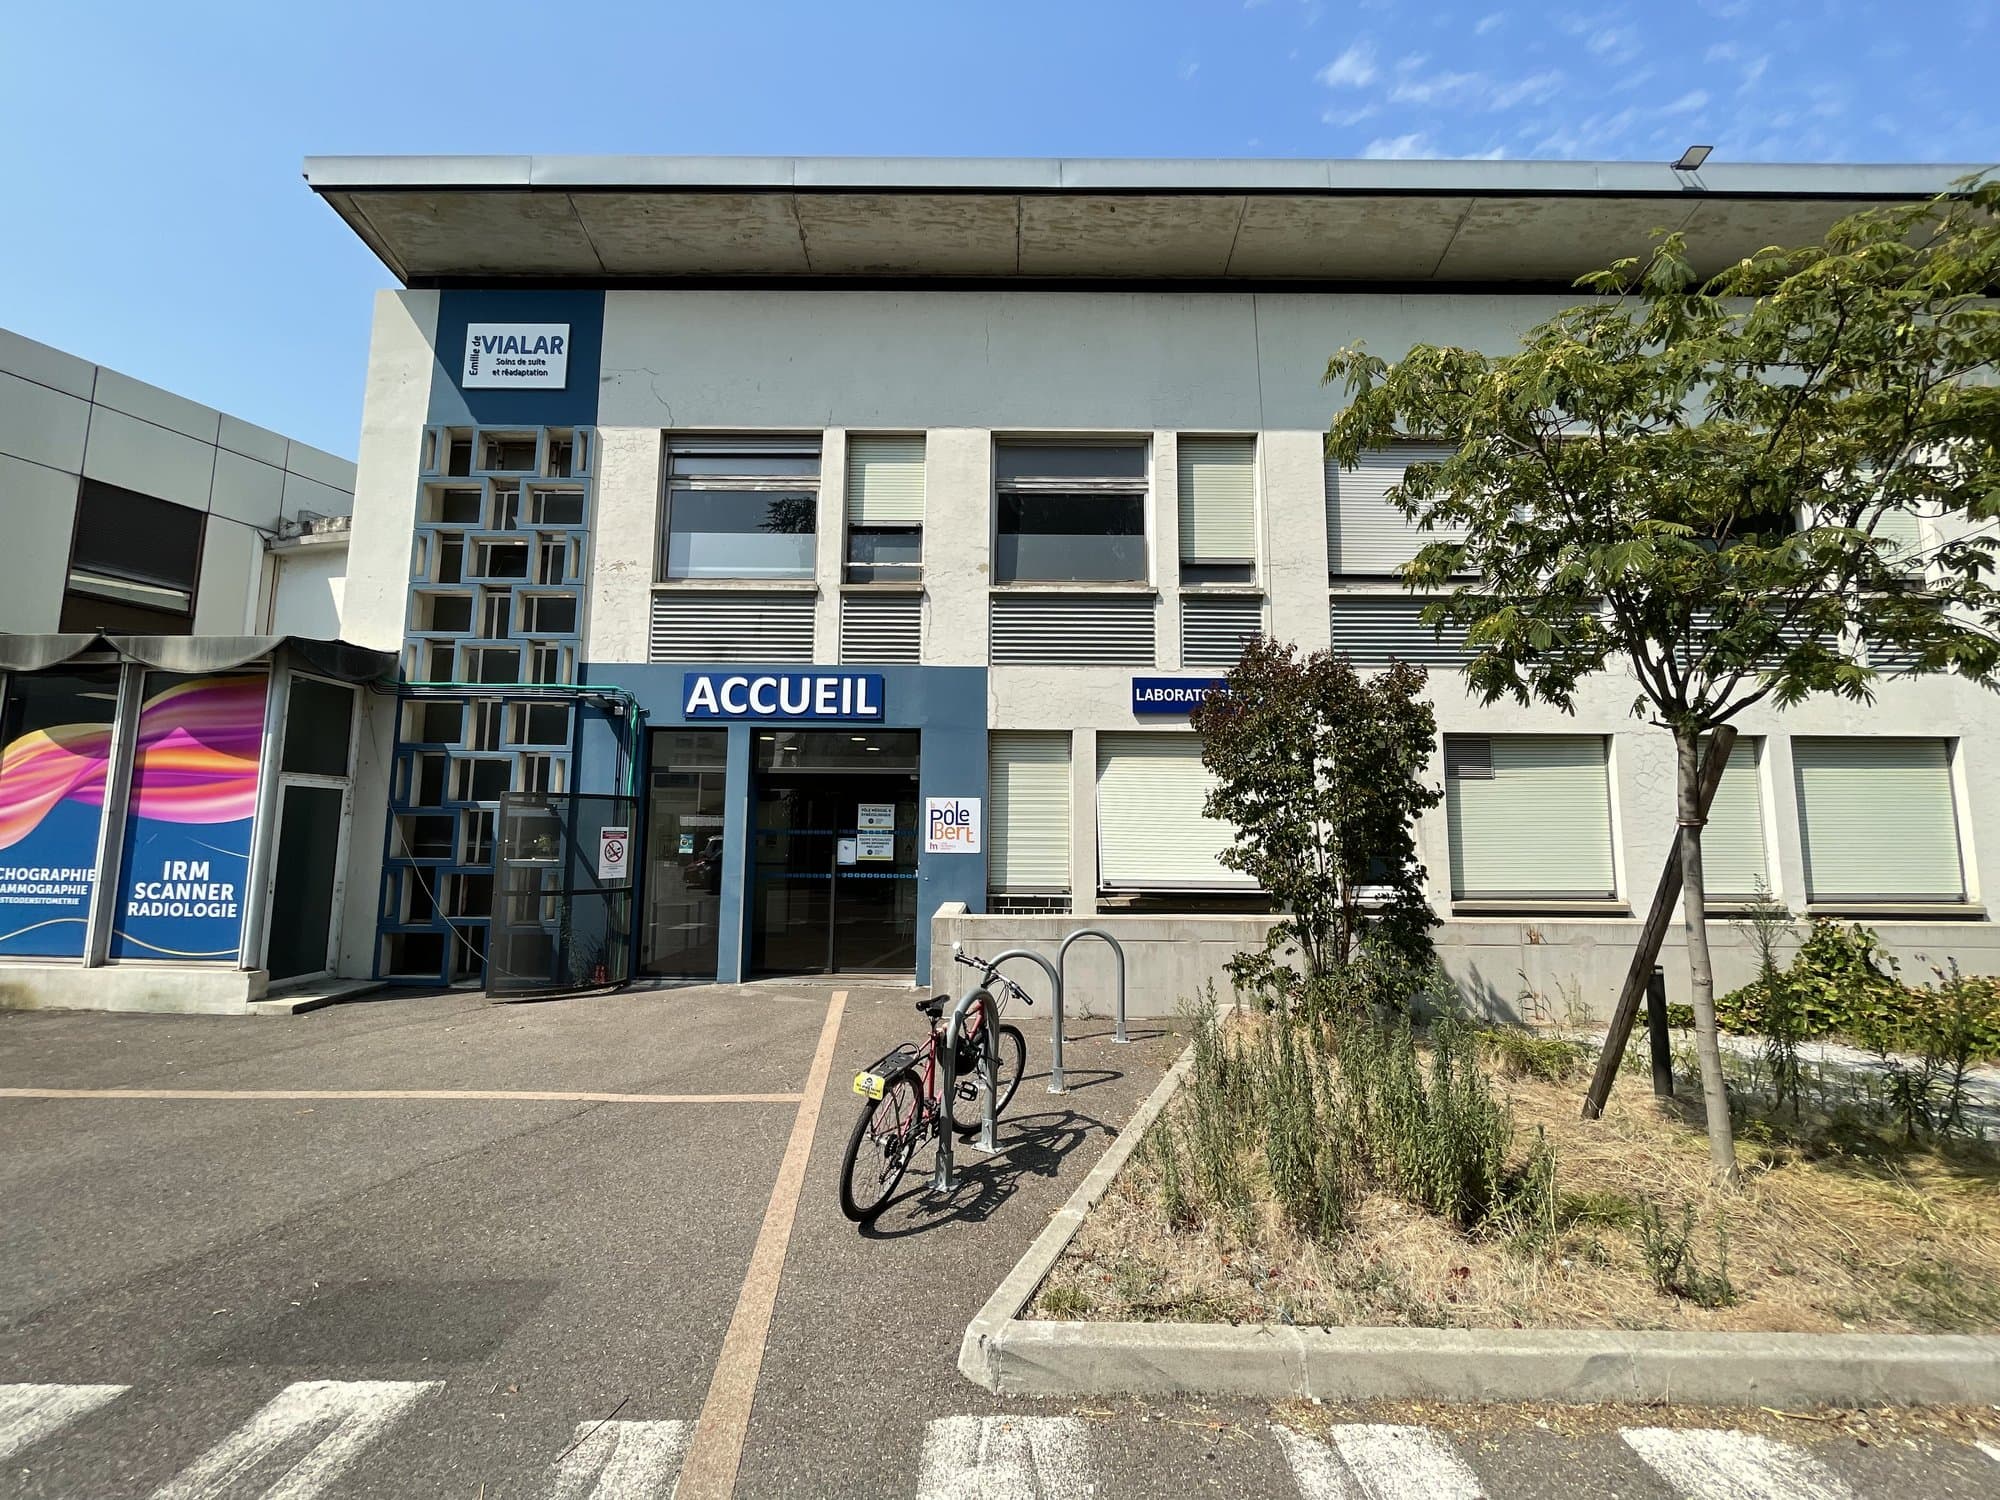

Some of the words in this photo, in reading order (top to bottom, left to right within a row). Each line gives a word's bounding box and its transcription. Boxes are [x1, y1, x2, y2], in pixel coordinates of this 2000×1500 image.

[471, 335, 481, 347] de
[482, 335, 564, 355] VIALAR
[496, 358, 516, 366] Soins
[517, 358, 527, 366] de
[528, 358, 546, 366] suite
[501, 368, 549, 377] réadaptation
[686, 676, 878, 715] ACCUEIL
[163, 861, 210, 881] IRM
[134, 882, 234, 901] SCANNER
[127, 902, 238, 918] RADIOLOGIE
